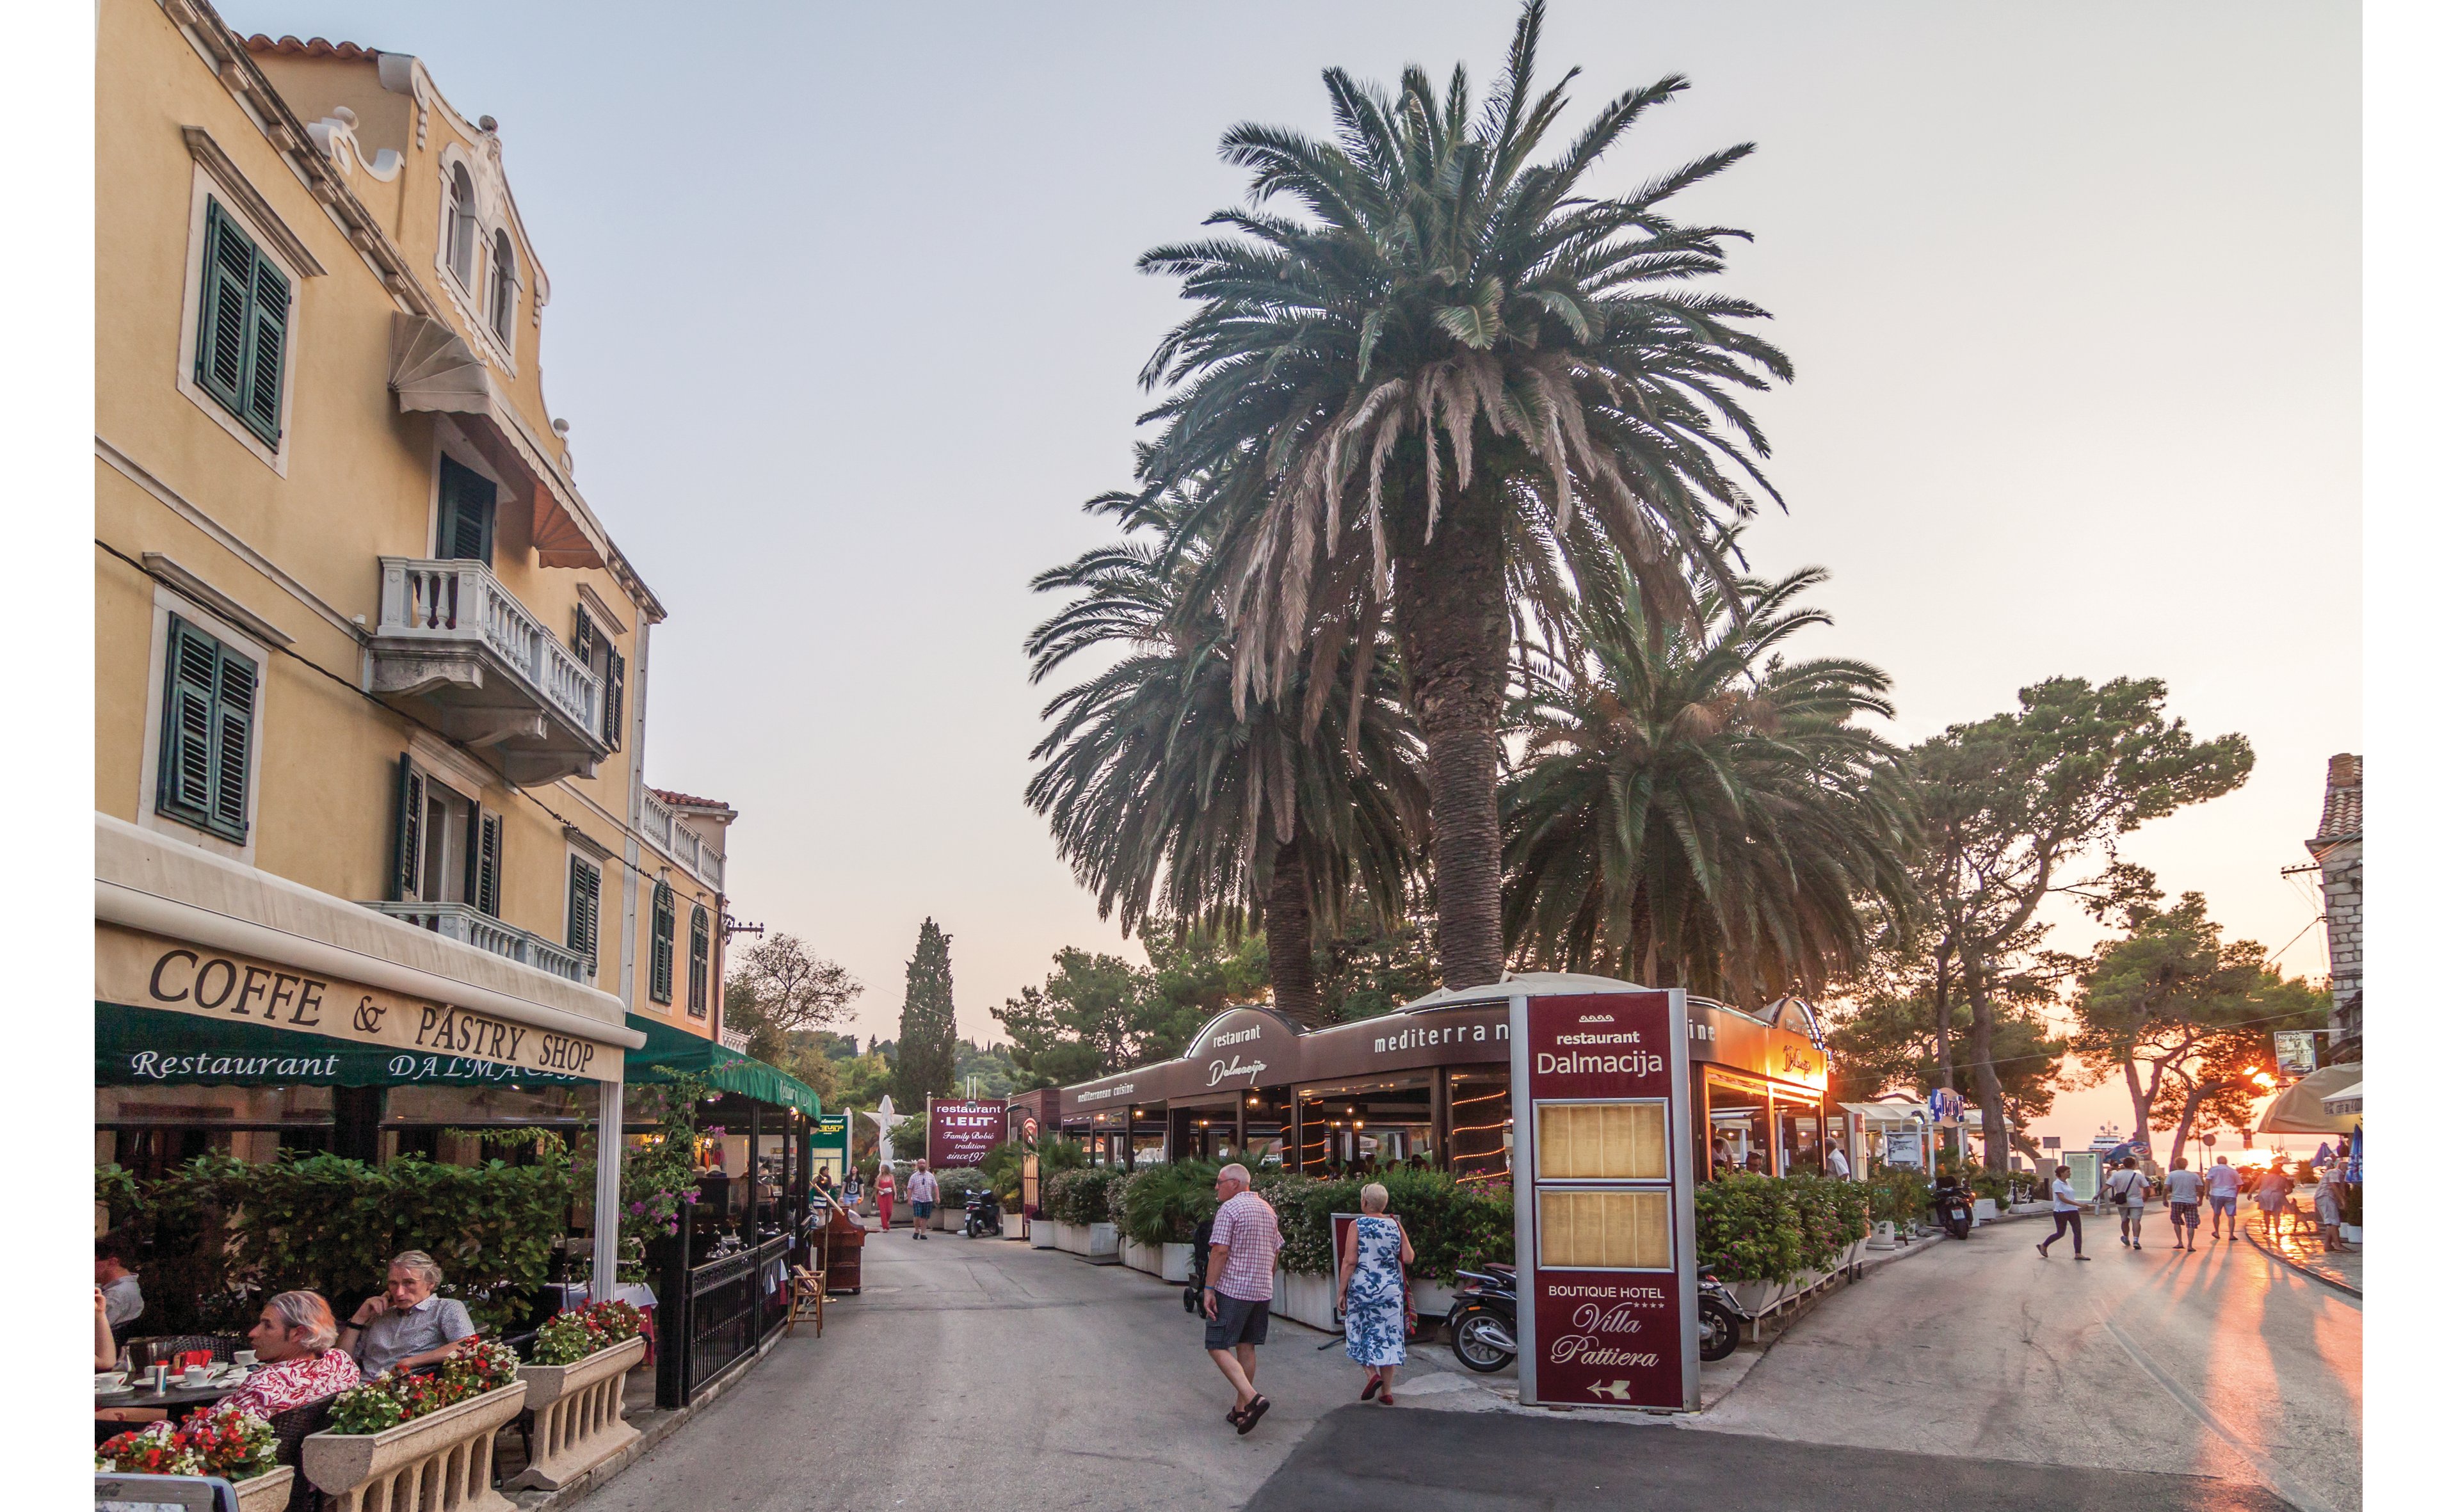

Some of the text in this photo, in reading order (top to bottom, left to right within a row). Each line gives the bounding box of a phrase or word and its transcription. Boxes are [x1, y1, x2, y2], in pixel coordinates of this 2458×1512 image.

[521, 438, 546, 480] VILLA
[149, 949, 594, 1073] COFFE & PASTRY SHOP
[1213, 1024, 1261, 1048] restaurant
[1374, 1024, 1509, 1053] mediterran
[1557, 1031, 1640, 1045] restaurant
[132, 1050, 340, 1079] Restaurant
[1206, 1055, 1267, 1086] Dalmacija
[1538, 1050, 1663, 1077] Dalmacija
[1077, 1082, 1134, 1102] mediterranean cuisine
[936, 1106, 1001, 1114] restaurant
[943, 1131, 970, 1141] Family
[954, 1141, 986, 1150] tradition
[946, 1152, 986, 1162] since197
[1548, 1285, 1665, 1299] BOUTIQUE HOTEL
[1573, 1302, 1642, 1334] Villa
[1550, 1335, 1659, 1367] Pattiera
